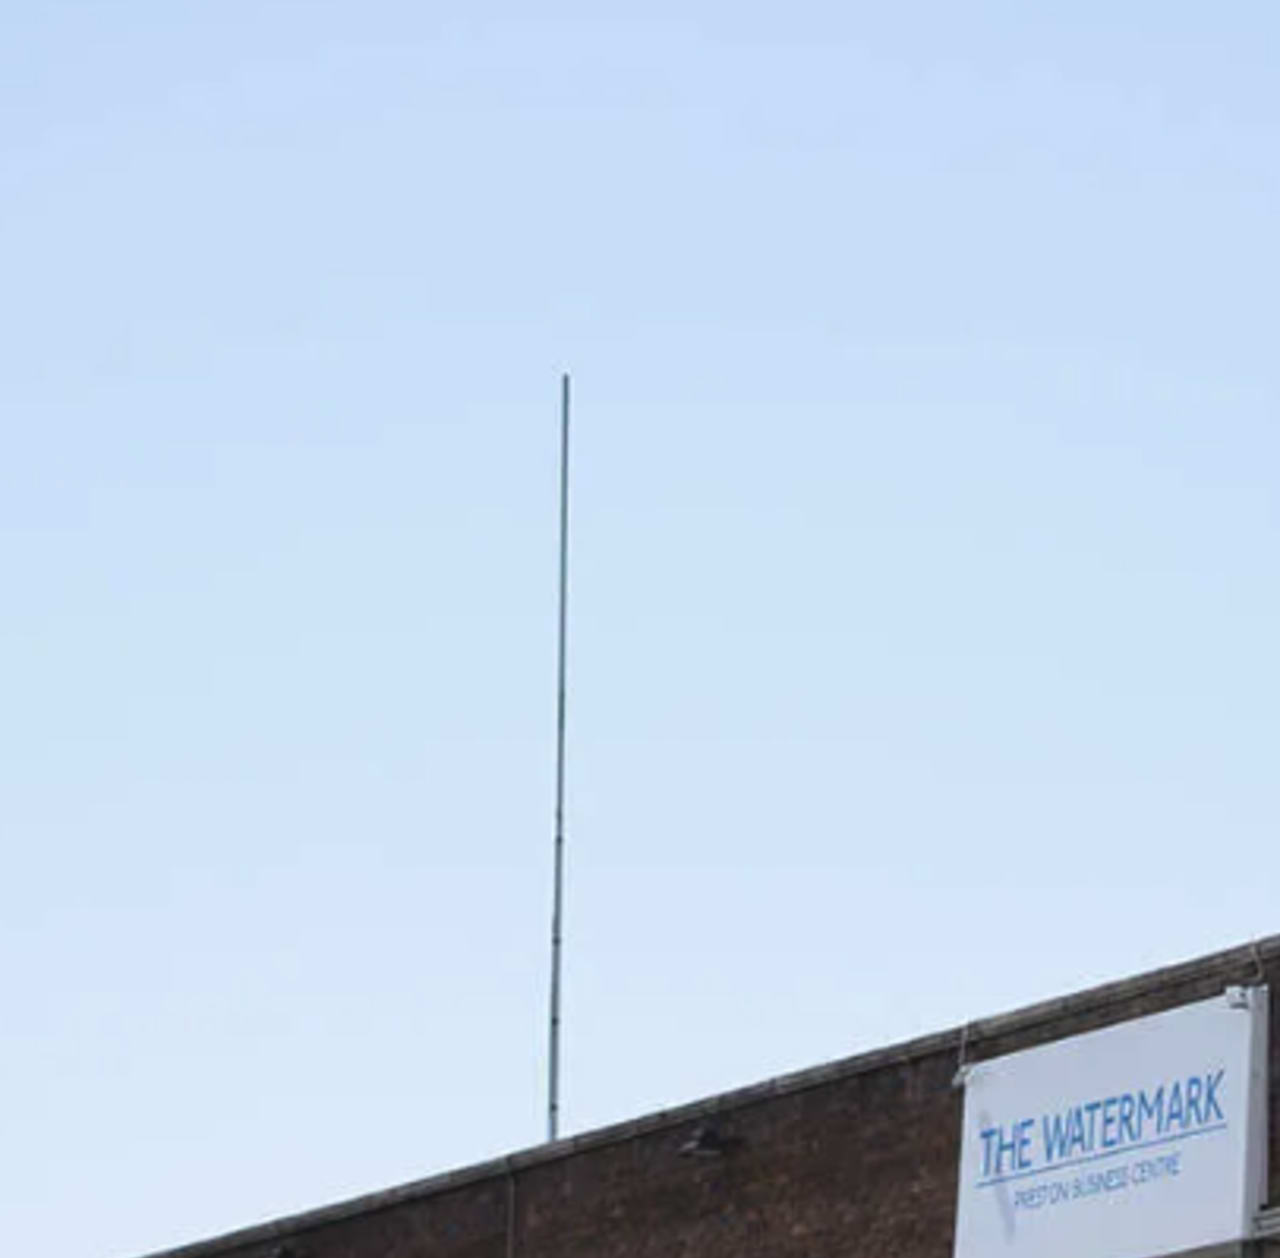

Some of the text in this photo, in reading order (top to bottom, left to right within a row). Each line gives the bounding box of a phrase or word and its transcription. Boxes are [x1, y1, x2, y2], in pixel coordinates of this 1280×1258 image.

[979, 1069, 1225, 1176] THE WATERMARK
[1014, 1152, 1181, 1208] PRESTON BUSINESS CENTRE
